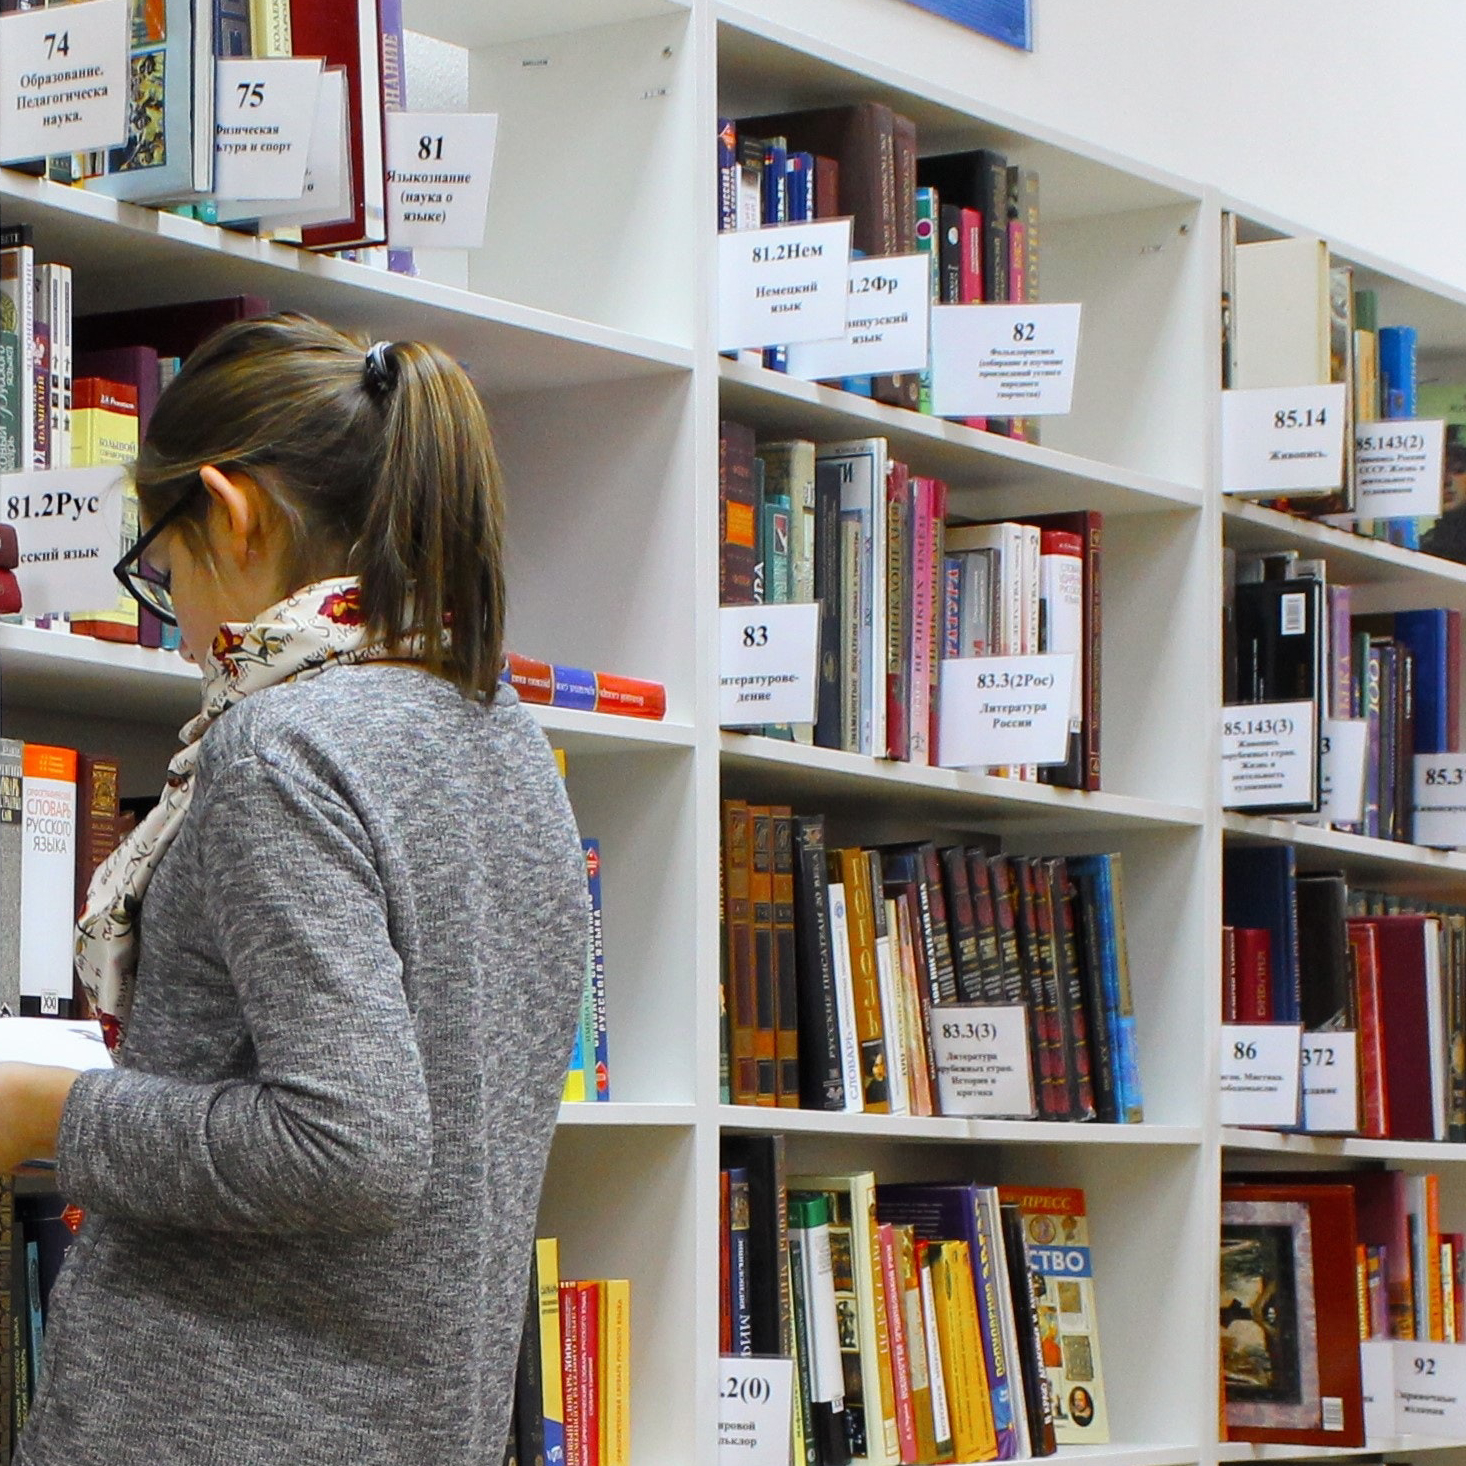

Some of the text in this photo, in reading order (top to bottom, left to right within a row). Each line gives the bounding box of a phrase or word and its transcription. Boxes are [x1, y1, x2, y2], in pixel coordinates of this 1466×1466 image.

[43, 30, 70, 60] 74
[20, 64, 105, 89] Образование.
[16, 84, 109, 111] Педагогическа
[236, 82, 266, 110] 75
[42, 111, 83, 128] наука.
[250, 139, 292, 157] и спорт
[417, 135, 445, 162] 81
[386, 170, 472, 187] Языкознание
[399, 189, 454, 207] (наука о
[403, 208, 448, 225] языке)
[751, 243, 824, 264] 81.2Нем
[755, 282, 818, 299] Немецкий
[770, 300, 803, 315] язык
[851, 331, 884, 345] язык
[1012, 322, 1036, 342] 82
[1273, 408, 1327, 429] 85.14
[1356, 434, 1425, 451] 85.143(2)
[6, 492, 100, 521] 81.2Рус
[63, 544, 100, 563] язык
[742, 625, 769, 649] 83
[976, 673, 1056, 691] 83.3(2Рос)
[736, 689, 772, 704] дение
[979, 700, 1048, 715] Литература
[991, 715, 1033, 730] России
[1224, 717, 1294, 736] 85.143(3)
[26, 799, 72, 819] СЛОВАРЬ
[25, 817, 73, 837] РУССКОГО
[33, 836, 67, 854] ЯЗЫКА
[851, 856, 880, 1041] ГОГОЛЬ
[941, 1022, 998, 1041] 83.3(3)
[1233, 1040, 1258, 1061] 86
[1302, 1048, 1335, 1066] 372
[1414, 1357, 1437, 1376] 92
